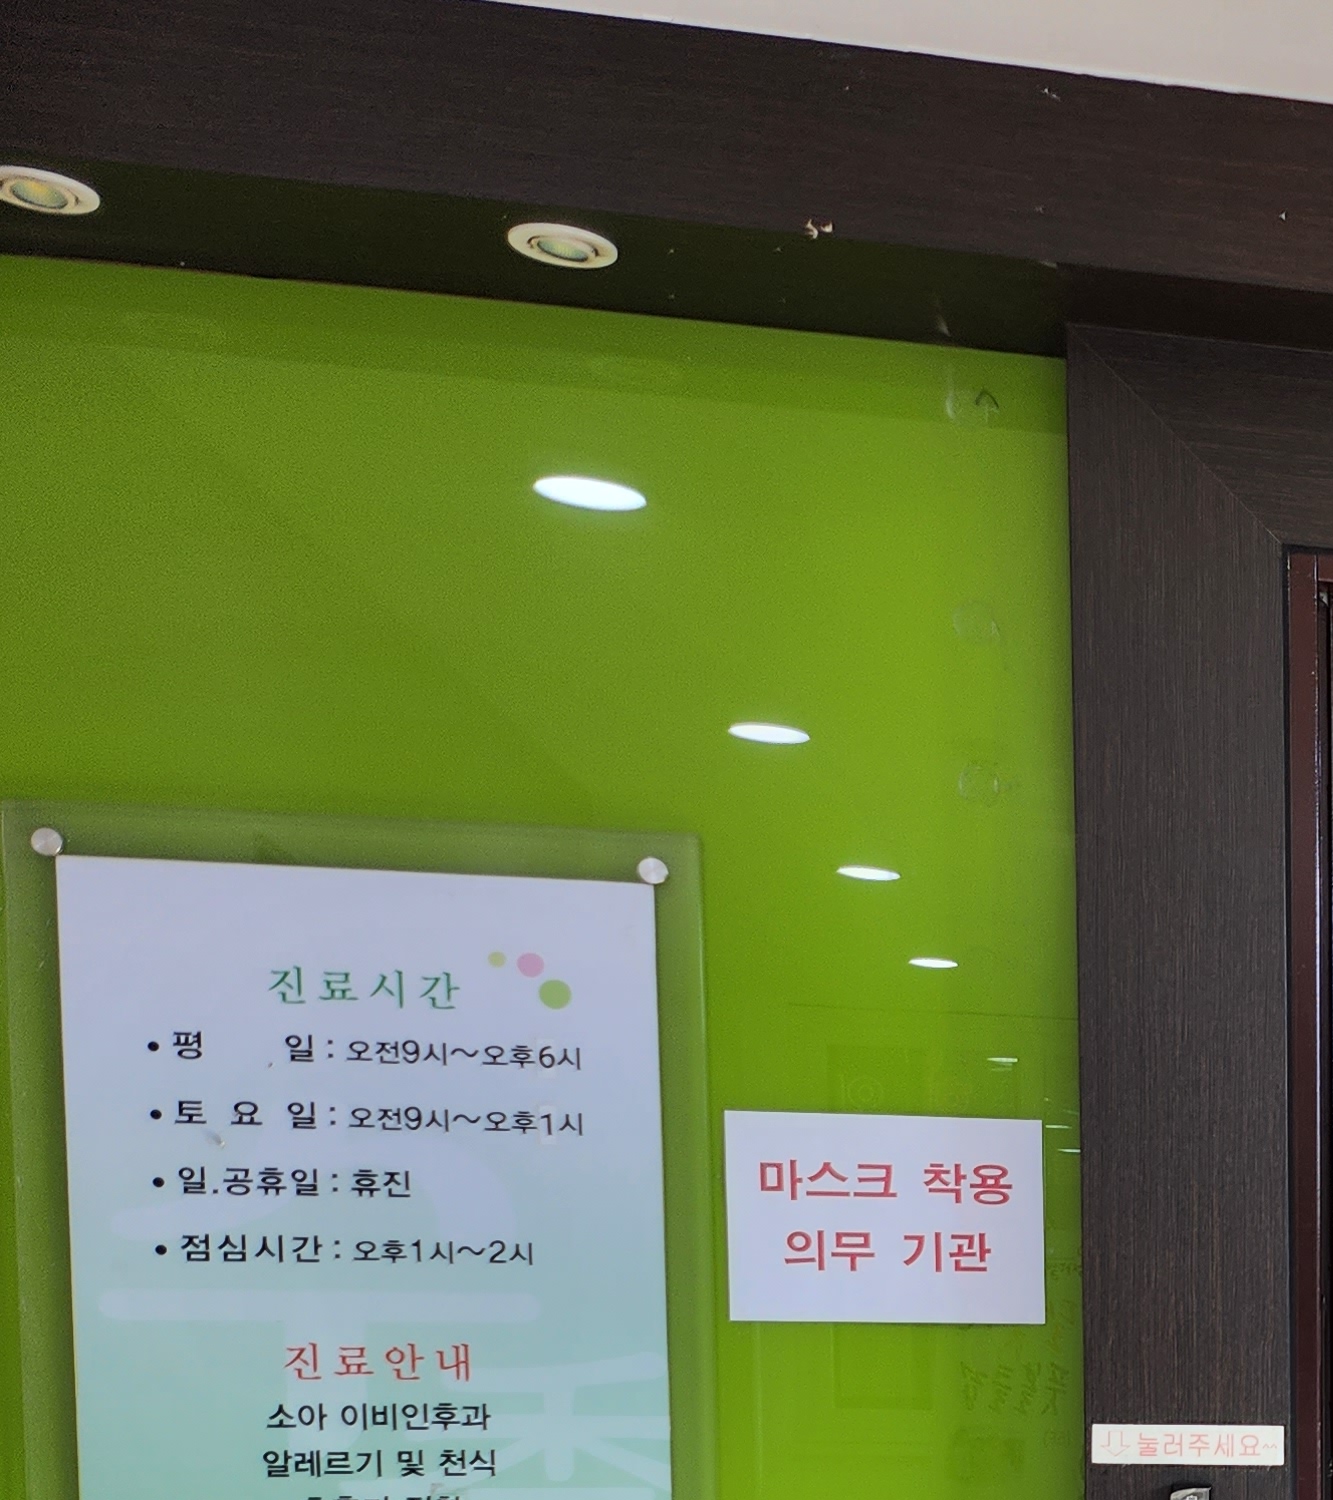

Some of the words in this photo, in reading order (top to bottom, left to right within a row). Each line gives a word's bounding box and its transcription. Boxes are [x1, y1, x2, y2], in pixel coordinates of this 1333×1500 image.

[268, 966, 460, 1010] 진료시간
[350, 1170, 411, 1198] 휴진
[759, 1159, 898, 1202] 마스크
[923, 1162, 1014, 1206] 착용
[784, 1229, 876, 1273] 의무
[902, 1230, 992, 1273] 기관
[283, 1342, 472, 1382] 진료안내
[266, 1403, 327, 1431] 소아
[341, 1402, 490, 1431] 이비인후과
[262, 1449, 383, 1478] 알레르기
[397, 1449, 424, 1477] 및
[439, 1449, 497, 1477] 천식
